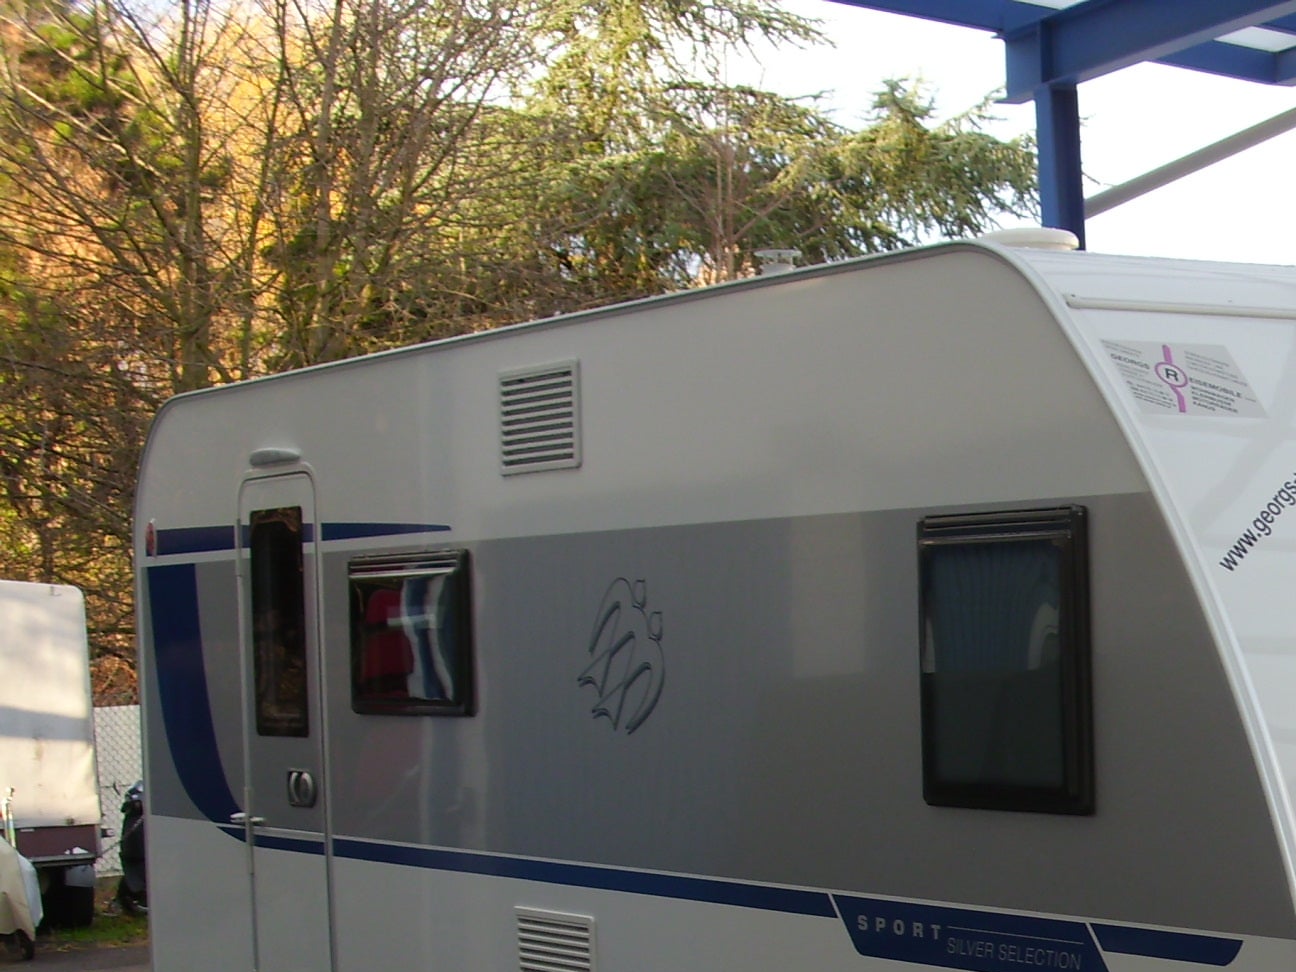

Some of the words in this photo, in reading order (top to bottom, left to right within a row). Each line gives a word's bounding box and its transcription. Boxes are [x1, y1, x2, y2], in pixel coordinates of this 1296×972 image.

[857, 915, 942, 940] SPORT
[946, 937, 994, 959] SILVER
[998, 944, 1082, 971] SELECTION
